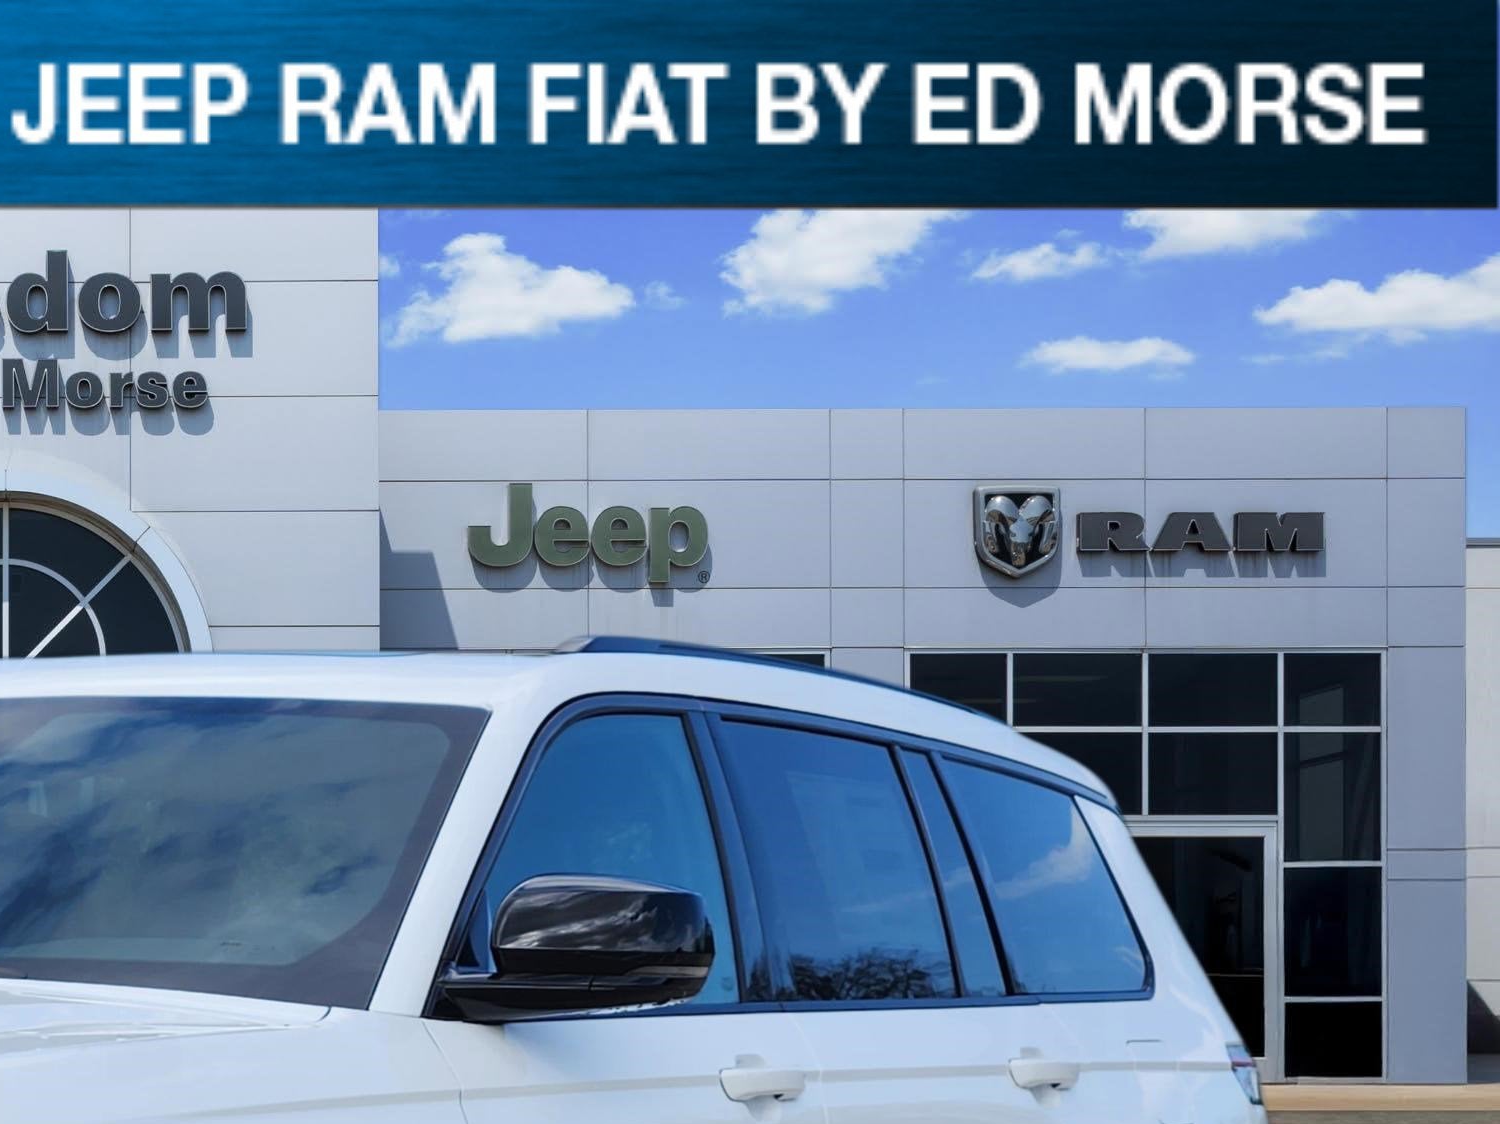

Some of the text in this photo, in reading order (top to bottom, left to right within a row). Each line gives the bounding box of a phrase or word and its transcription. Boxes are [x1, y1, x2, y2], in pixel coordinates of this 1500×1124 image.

[1, 357, 209, 411] Morse
[466, 482, 709, 584] Jeep
[1075, 510, 1326, 552] RAM
